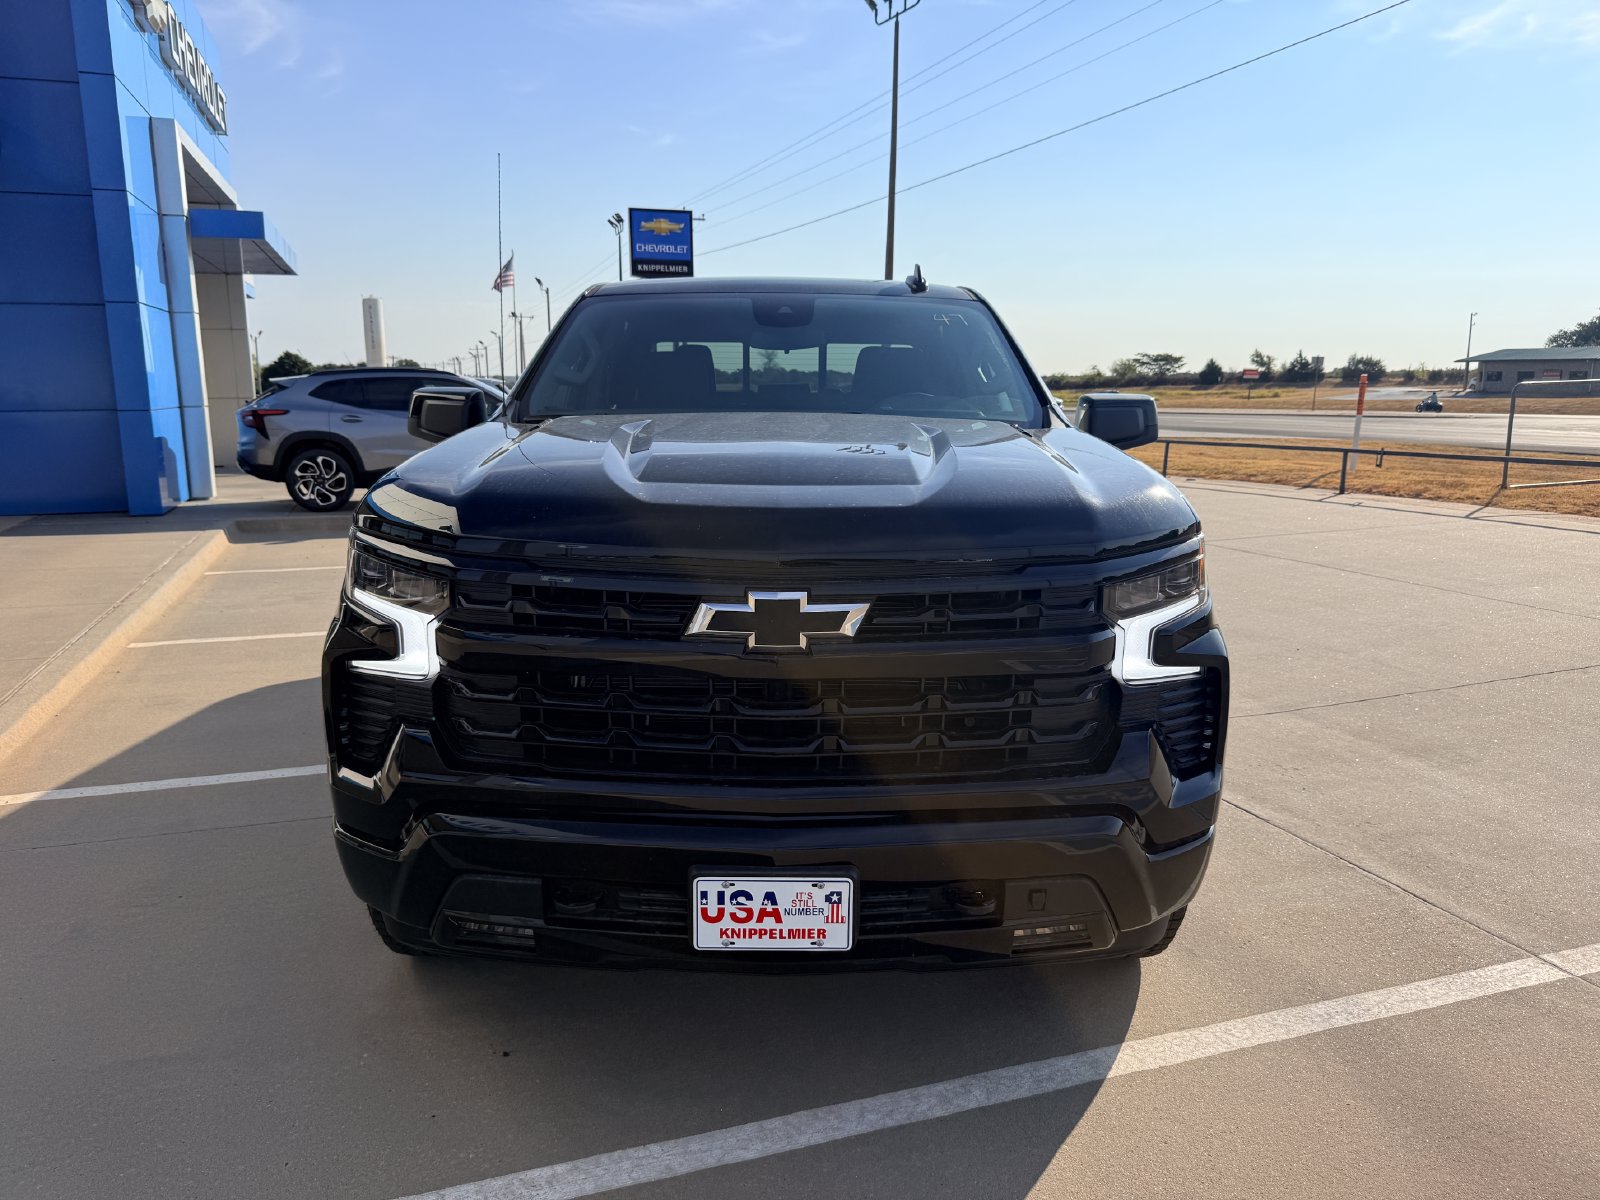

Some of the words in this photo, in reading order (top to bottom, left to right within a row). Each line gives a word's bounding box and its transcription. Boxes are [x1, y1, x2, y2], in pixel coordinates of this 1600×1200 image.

[636, 243, 688, 253] CHEVROLET
[637, 264, 688, 272] KNIPPELMIER
[795, 891, 813, 900] IT'S
[700, 889, 783, 924] USA
[791, 899, 817, 908] STILL
[784, 907, 825, 916] NUMBER
[719, 928, 827, 939] KNIPPELMIER
